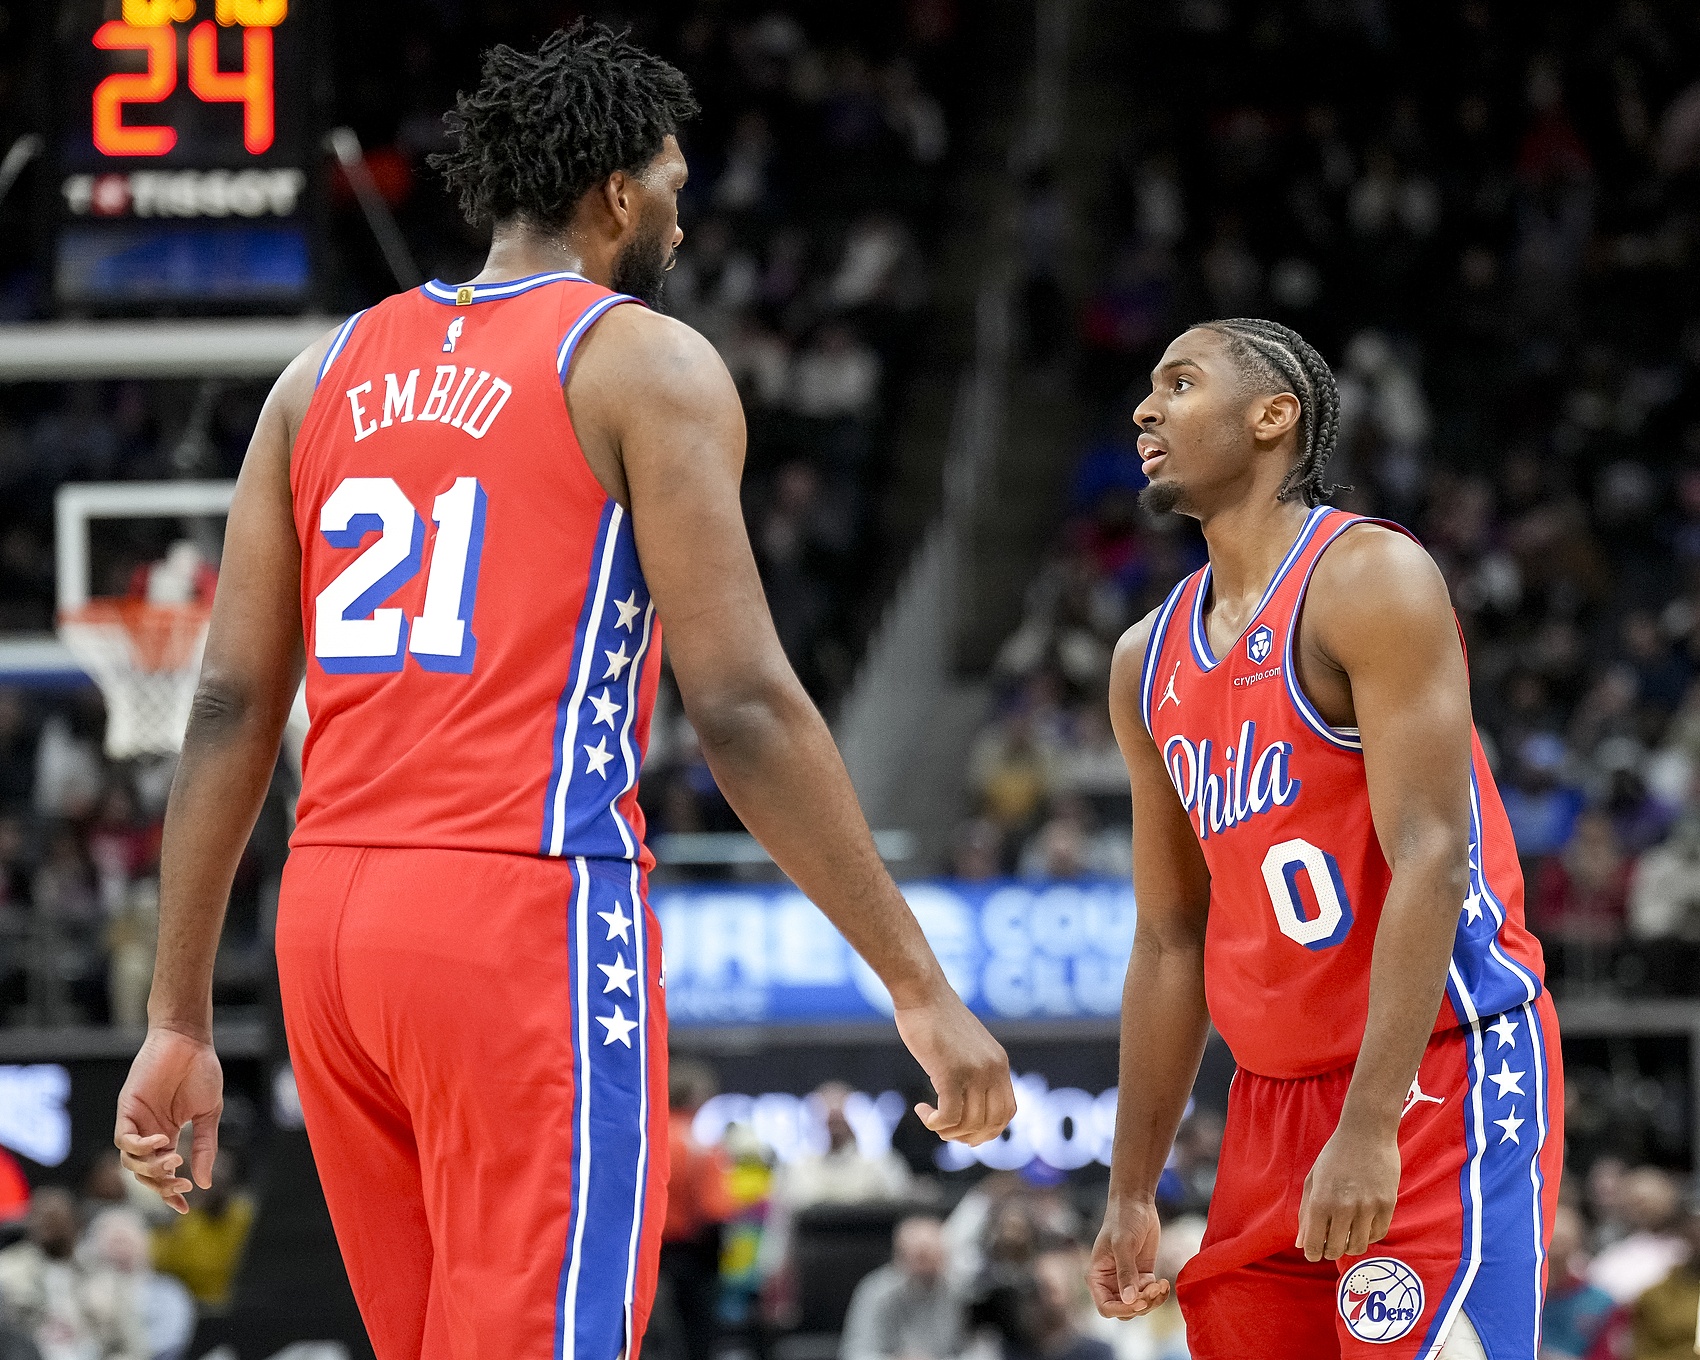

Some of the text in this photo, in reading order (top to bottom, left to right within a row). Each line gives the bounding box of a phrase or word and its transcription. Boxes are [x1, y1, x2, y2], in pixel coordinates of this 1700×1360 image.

[92, 20, 275, 156] 24
[346, 364, 512, 443] EMBIID
[314, 476, 489, 675] 21
[1233, 666, 1282, 687] crypto.com
[1163, 719, 1302, 840] Phila
[1260, 838, 1355, 952] 0
[1348, 1288, 1415, 1323] 76ers
